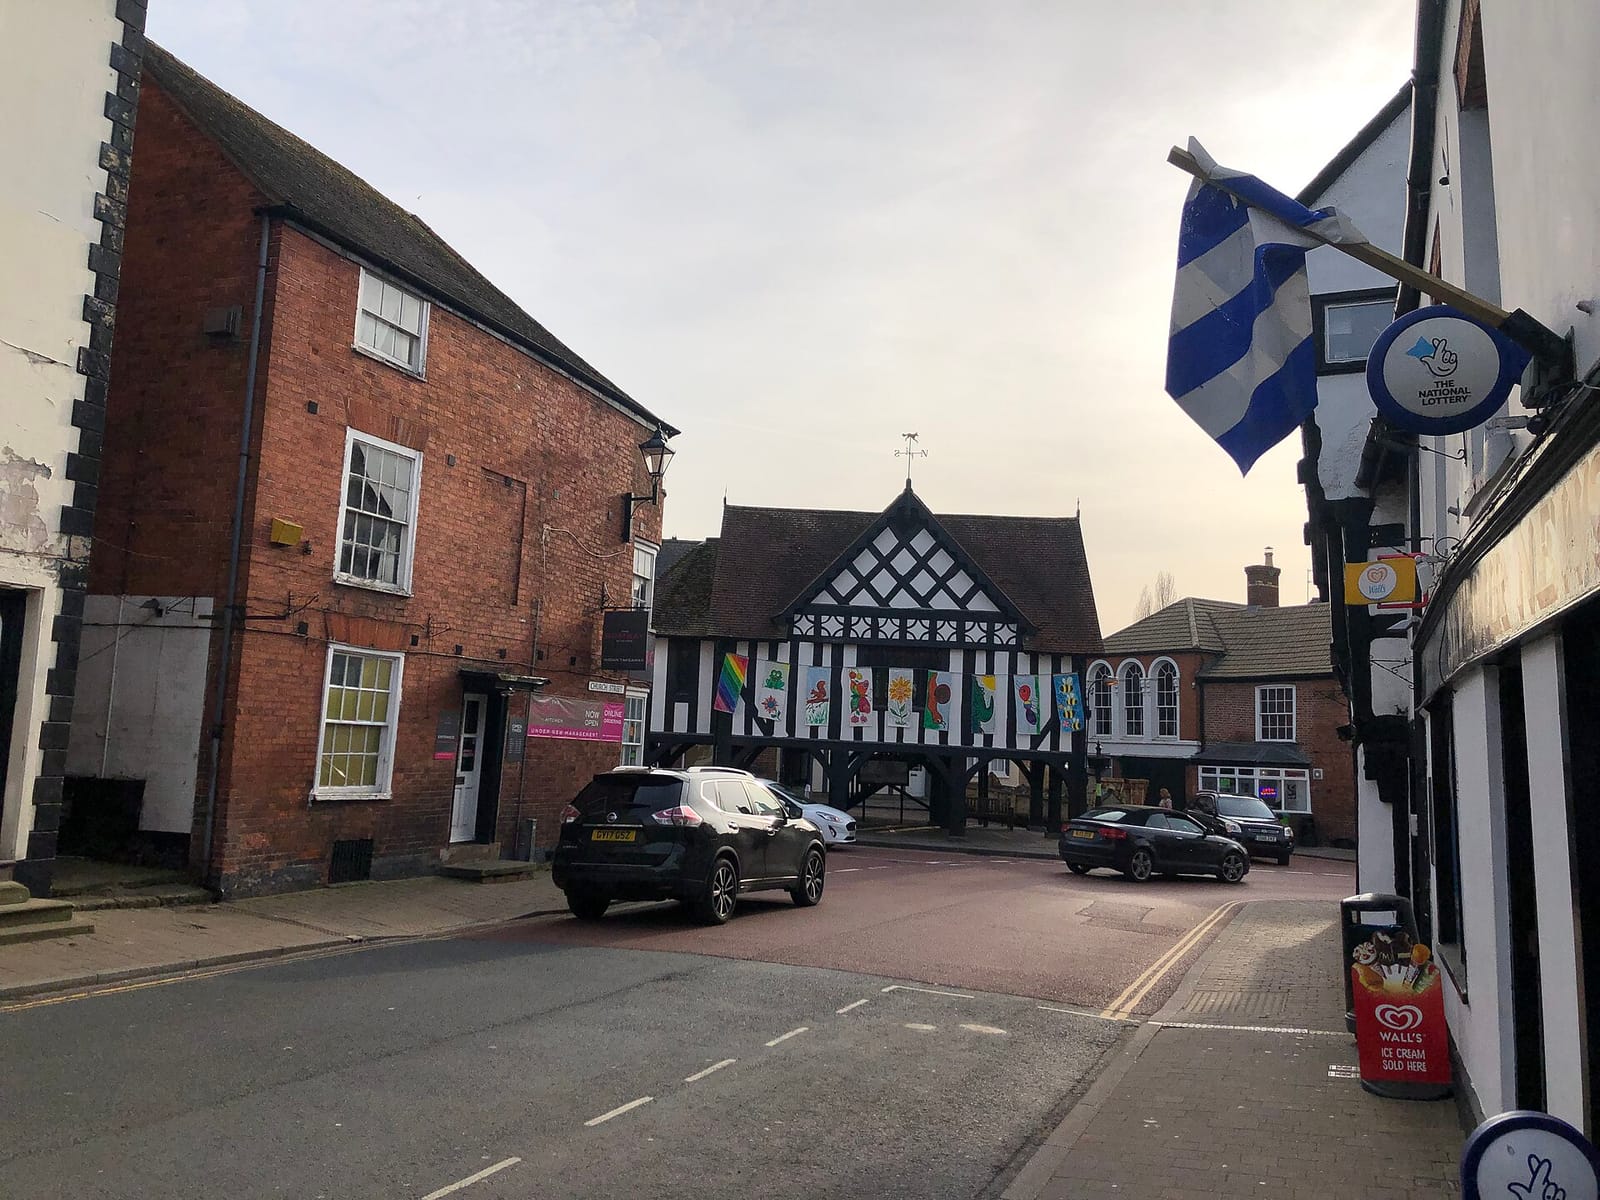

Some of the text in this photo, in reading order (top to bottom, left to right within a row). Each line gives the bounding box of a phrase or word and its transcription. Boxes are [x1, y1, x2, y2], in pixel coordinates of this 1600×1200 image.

[1434, 380, 1455, 388] THE
[1418, 387, 1471, 398] NATIONAL
[1422, 394, 1469, 406] LOTTERY
[590, 682, 623, 693] CHURCH STREET
[585, 710, 600, 719] NOW
[603, 709, 623, 718] ONLINE
[584, 719, 599, 727] OPEN
[1379, 1031, 1423, 1043] WALL'S
[1381, 1047, 1426, 1060] ICE CREAM
[1382, 1059, 1427, 1072] SOLD HERE
